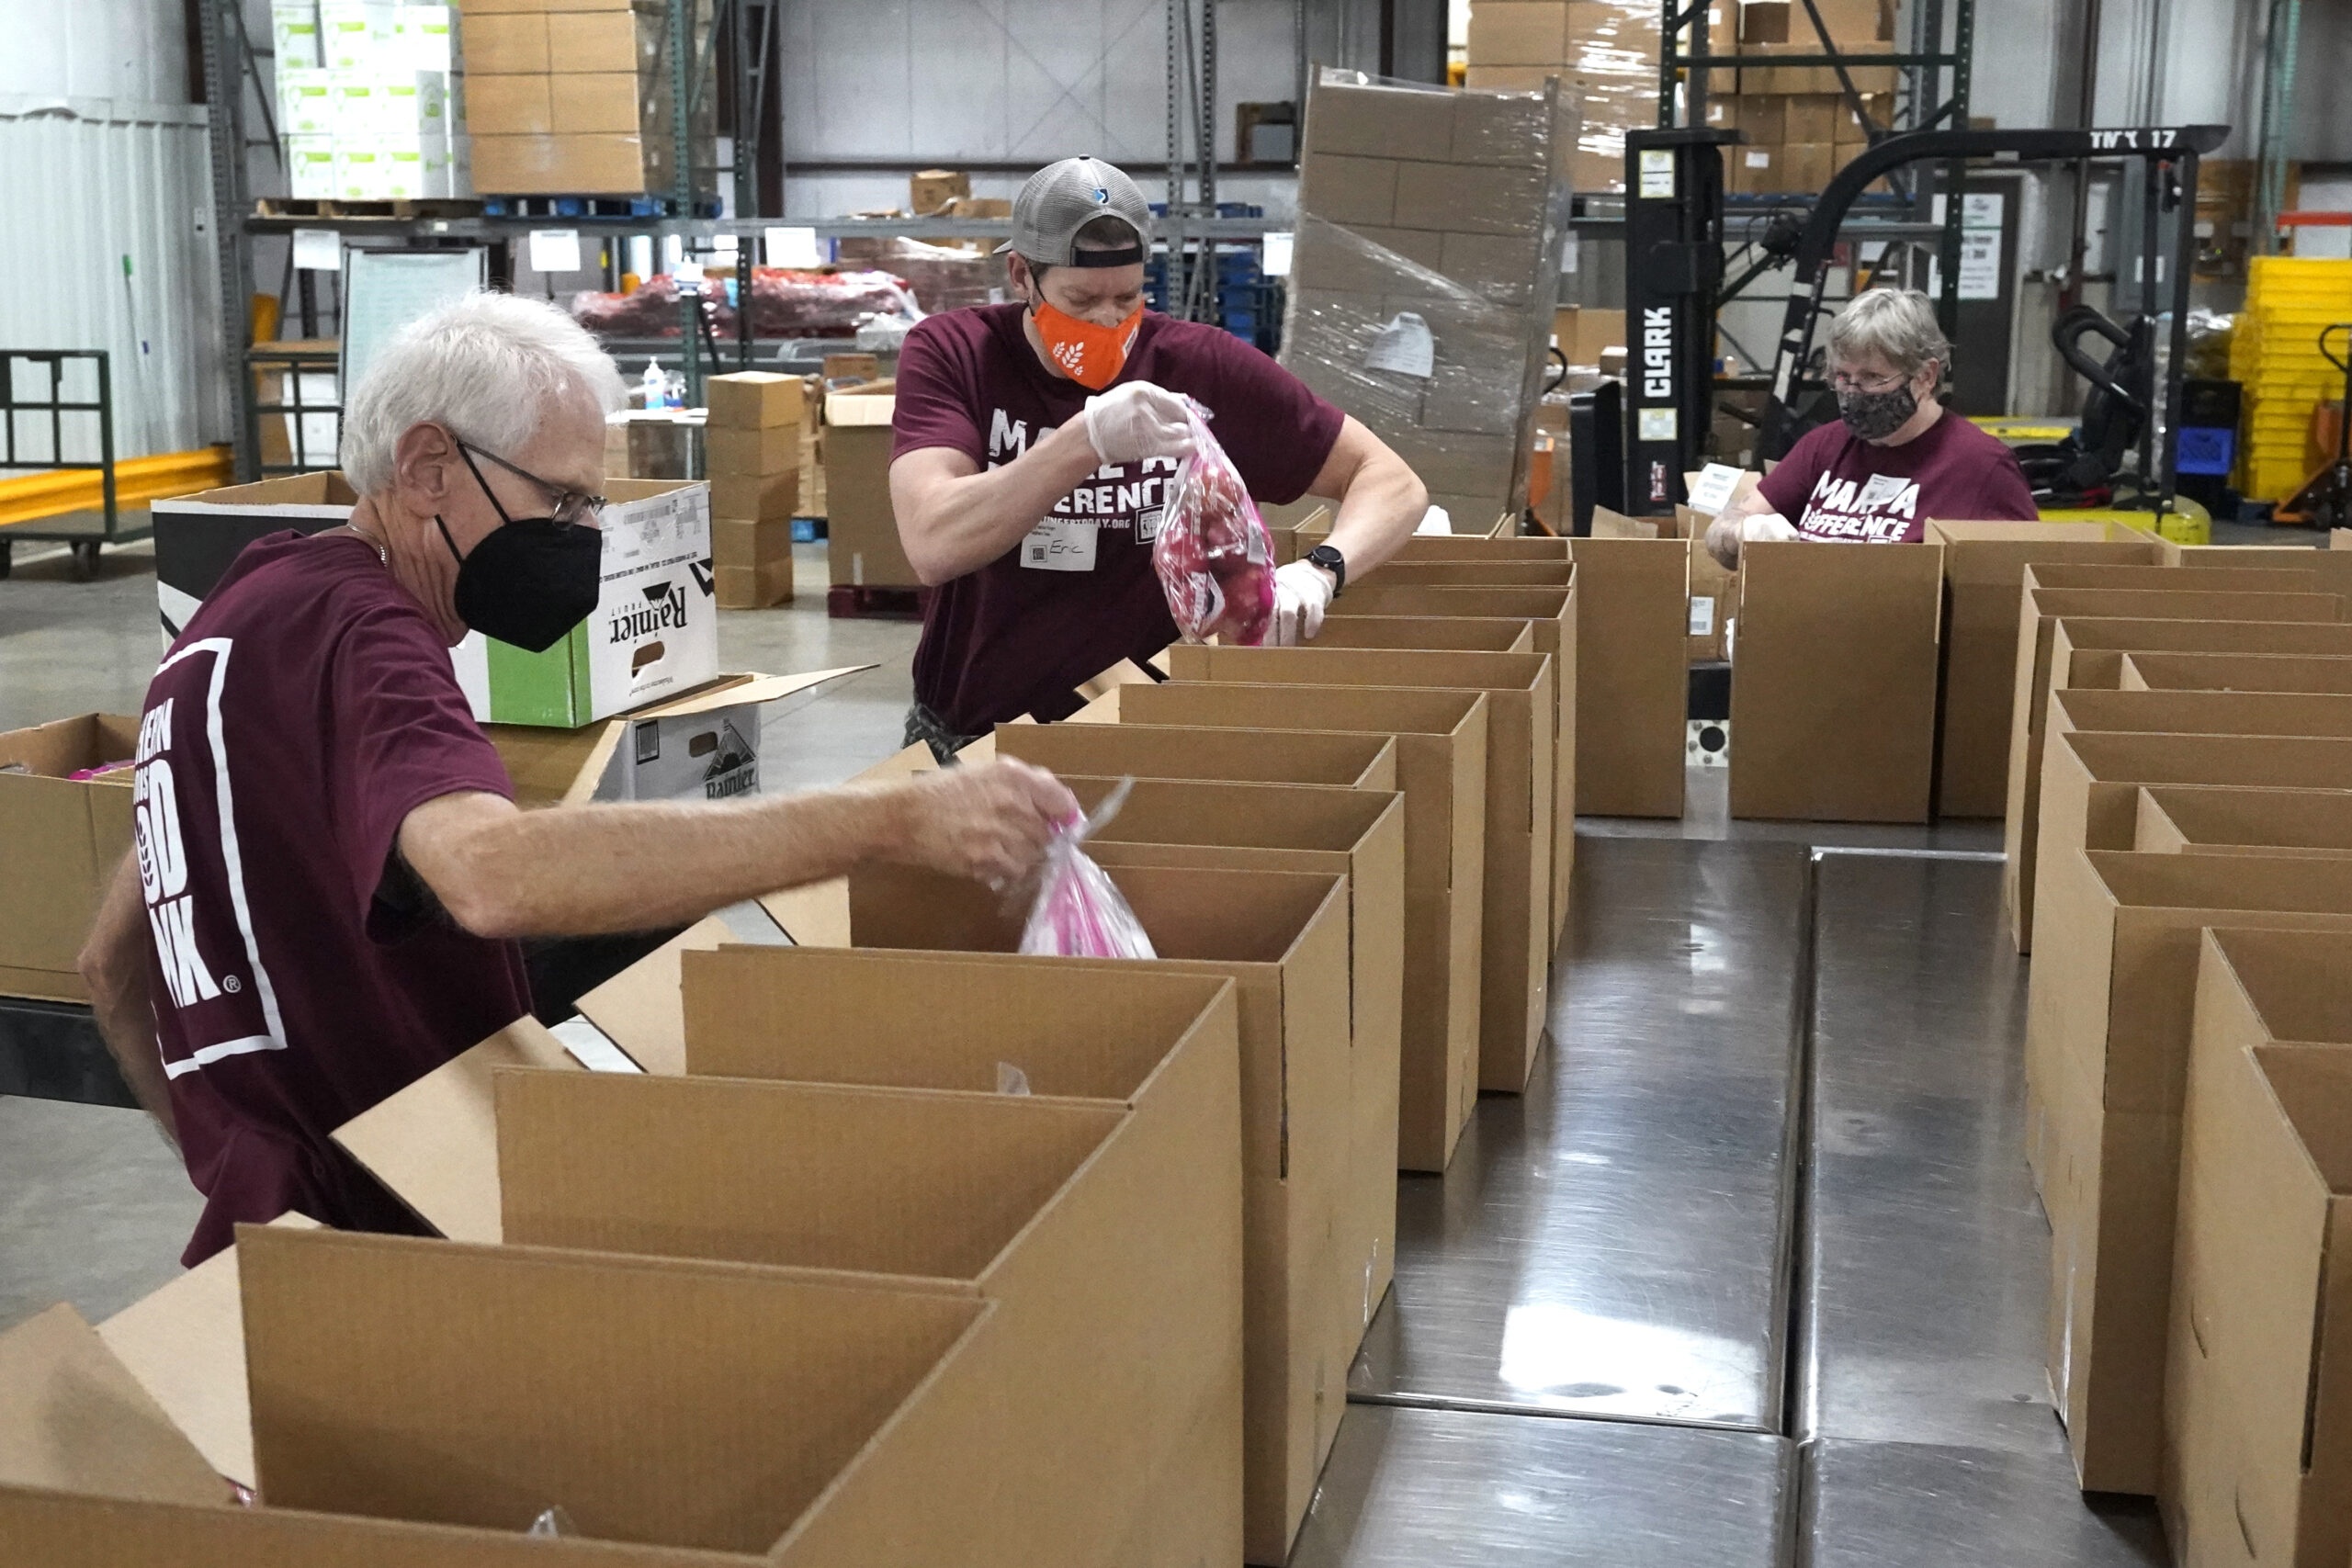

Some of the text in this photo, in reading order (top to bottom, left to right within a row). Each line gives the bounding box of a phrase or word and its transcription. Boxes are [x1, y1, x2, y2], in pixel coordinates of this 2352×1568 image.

[2151, 129, 2177, 149] 17
[1644, 306, 1672, 398] CLARK
[1887, 483, 1921, 520] A
[610, 586, 689, 645] Rainier
